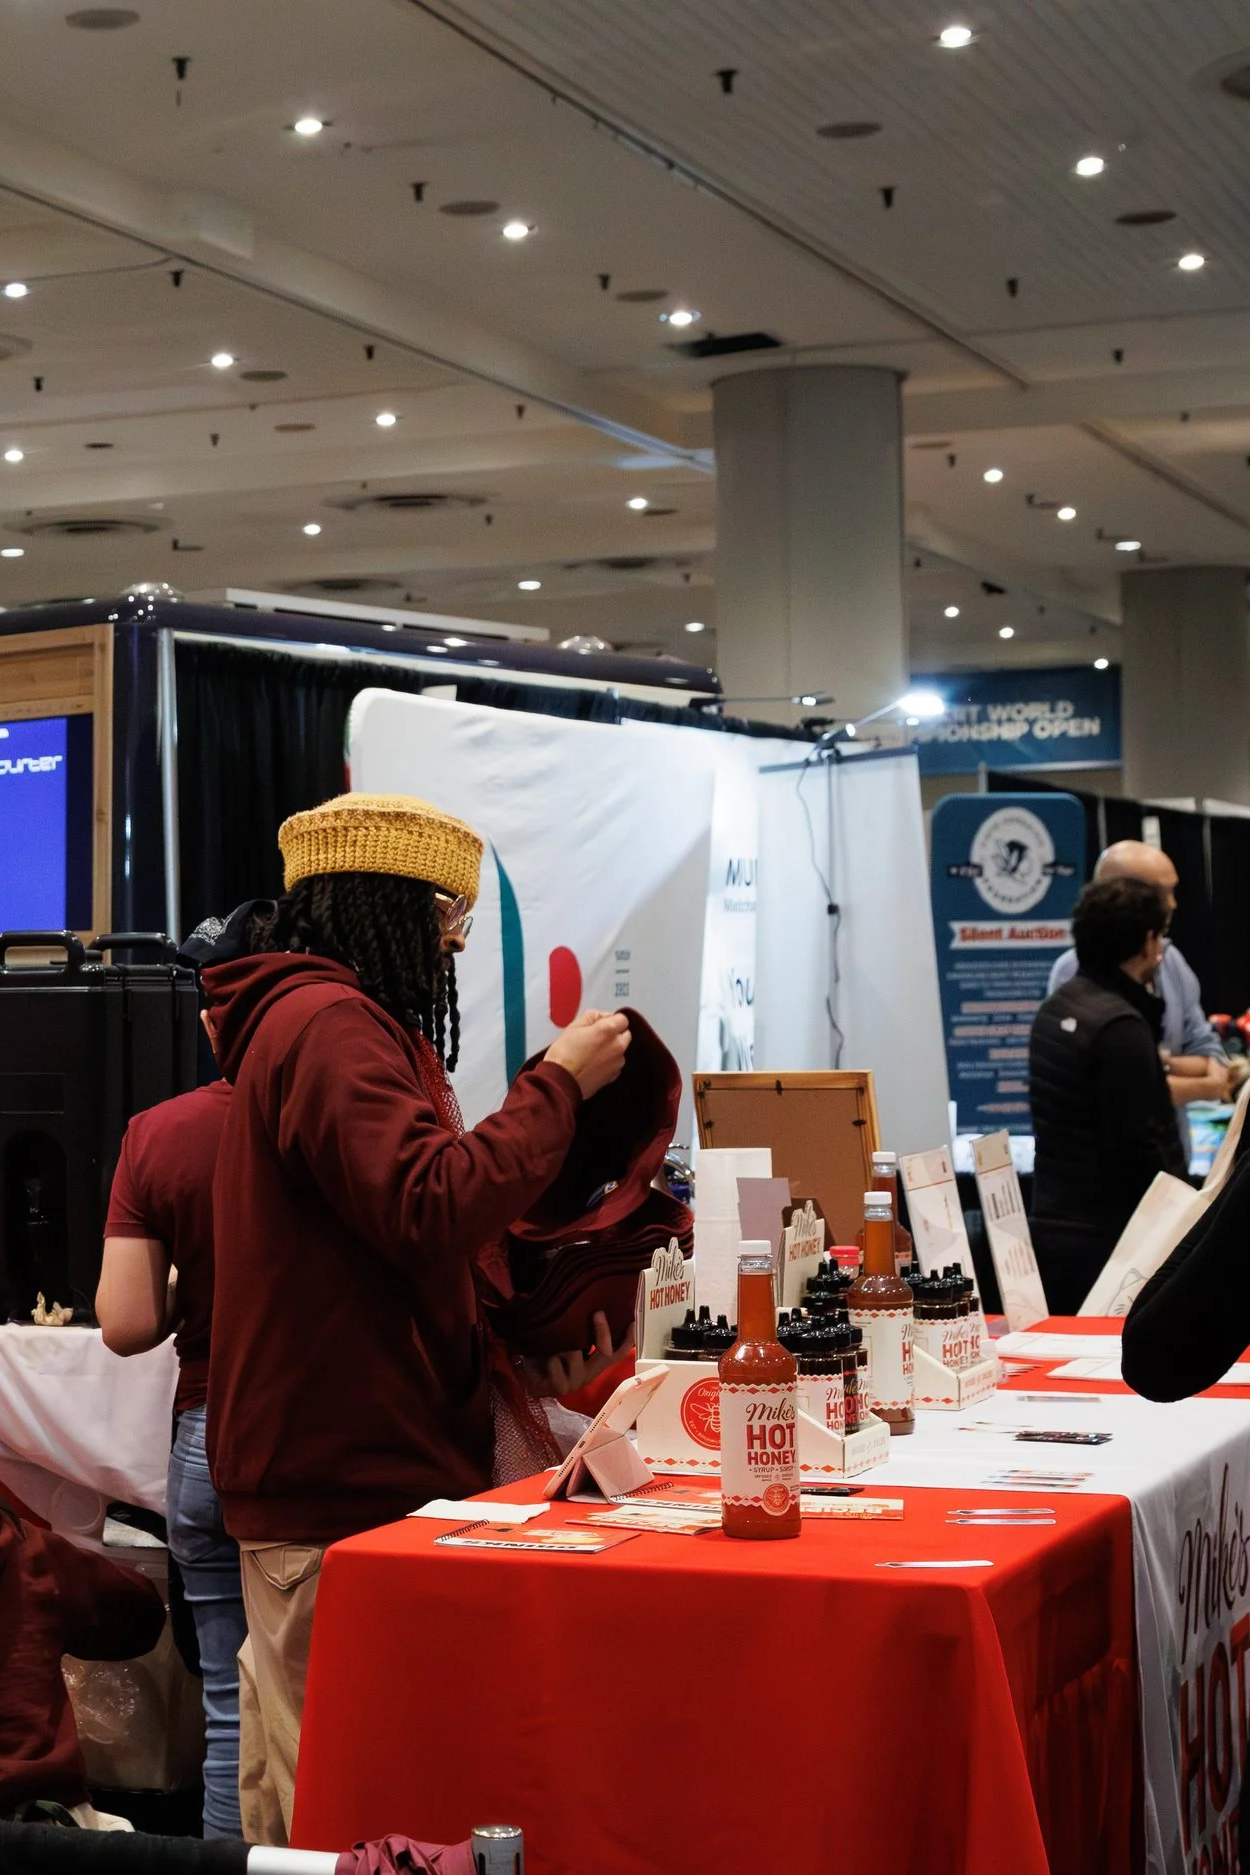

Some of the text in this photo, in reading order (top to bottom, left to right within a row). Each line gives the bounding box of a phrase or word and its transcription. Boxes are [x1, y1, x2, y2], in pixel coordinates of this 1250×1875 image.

[650, 1281, 691, 1310] HOT HONEY
[746, 1398, 795, 1421] Mike's
[826, 1401, 844, 1420] HO
[746, 1422, 796, 1450] HOT
[747, 1449, 796, 1466] HONEY
